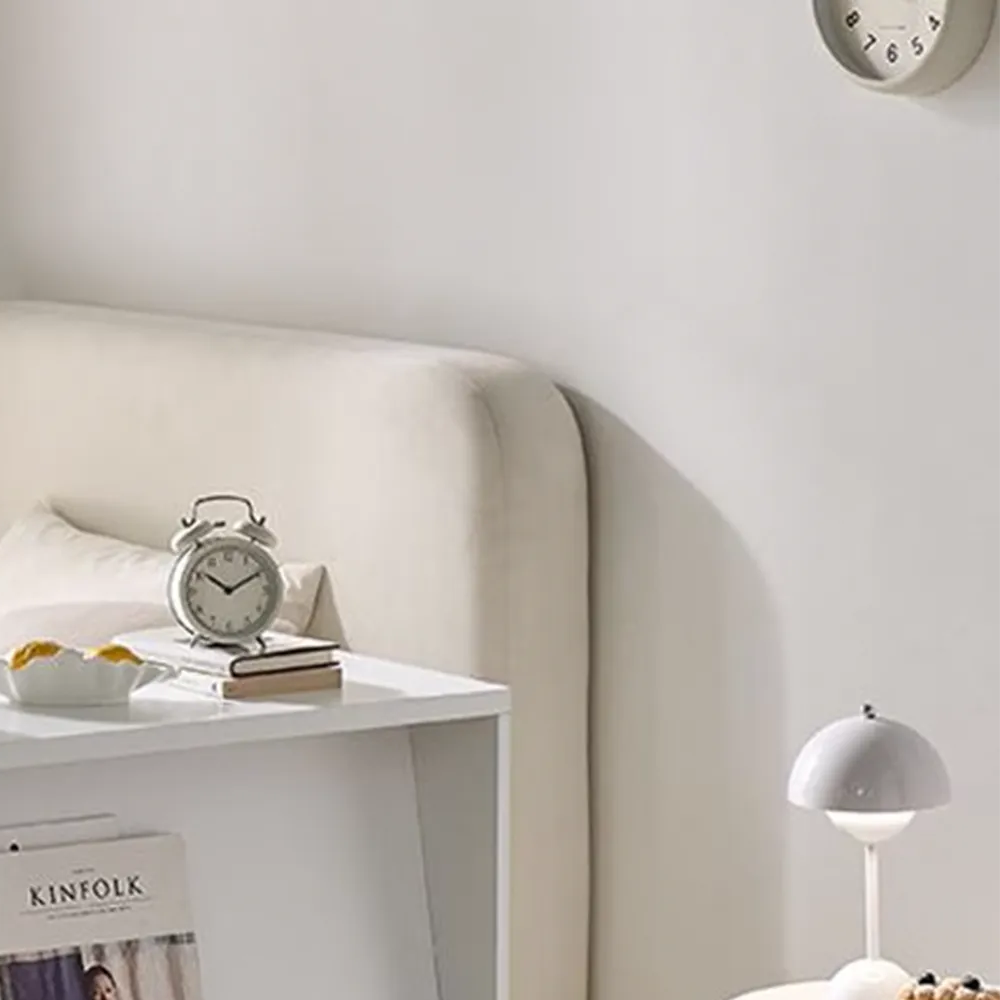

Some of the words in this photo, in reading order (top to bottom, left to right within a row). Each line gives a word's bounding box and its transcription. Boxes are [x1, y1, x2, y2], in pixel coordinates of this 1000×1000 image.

[846, 10, 861, 28] 8
[864, 34, 877, 51] 7
[911, 36, 924, 56] 5
[887, 43, 898, 63] 6
[29, 875, 143, 906] KINFOLK
